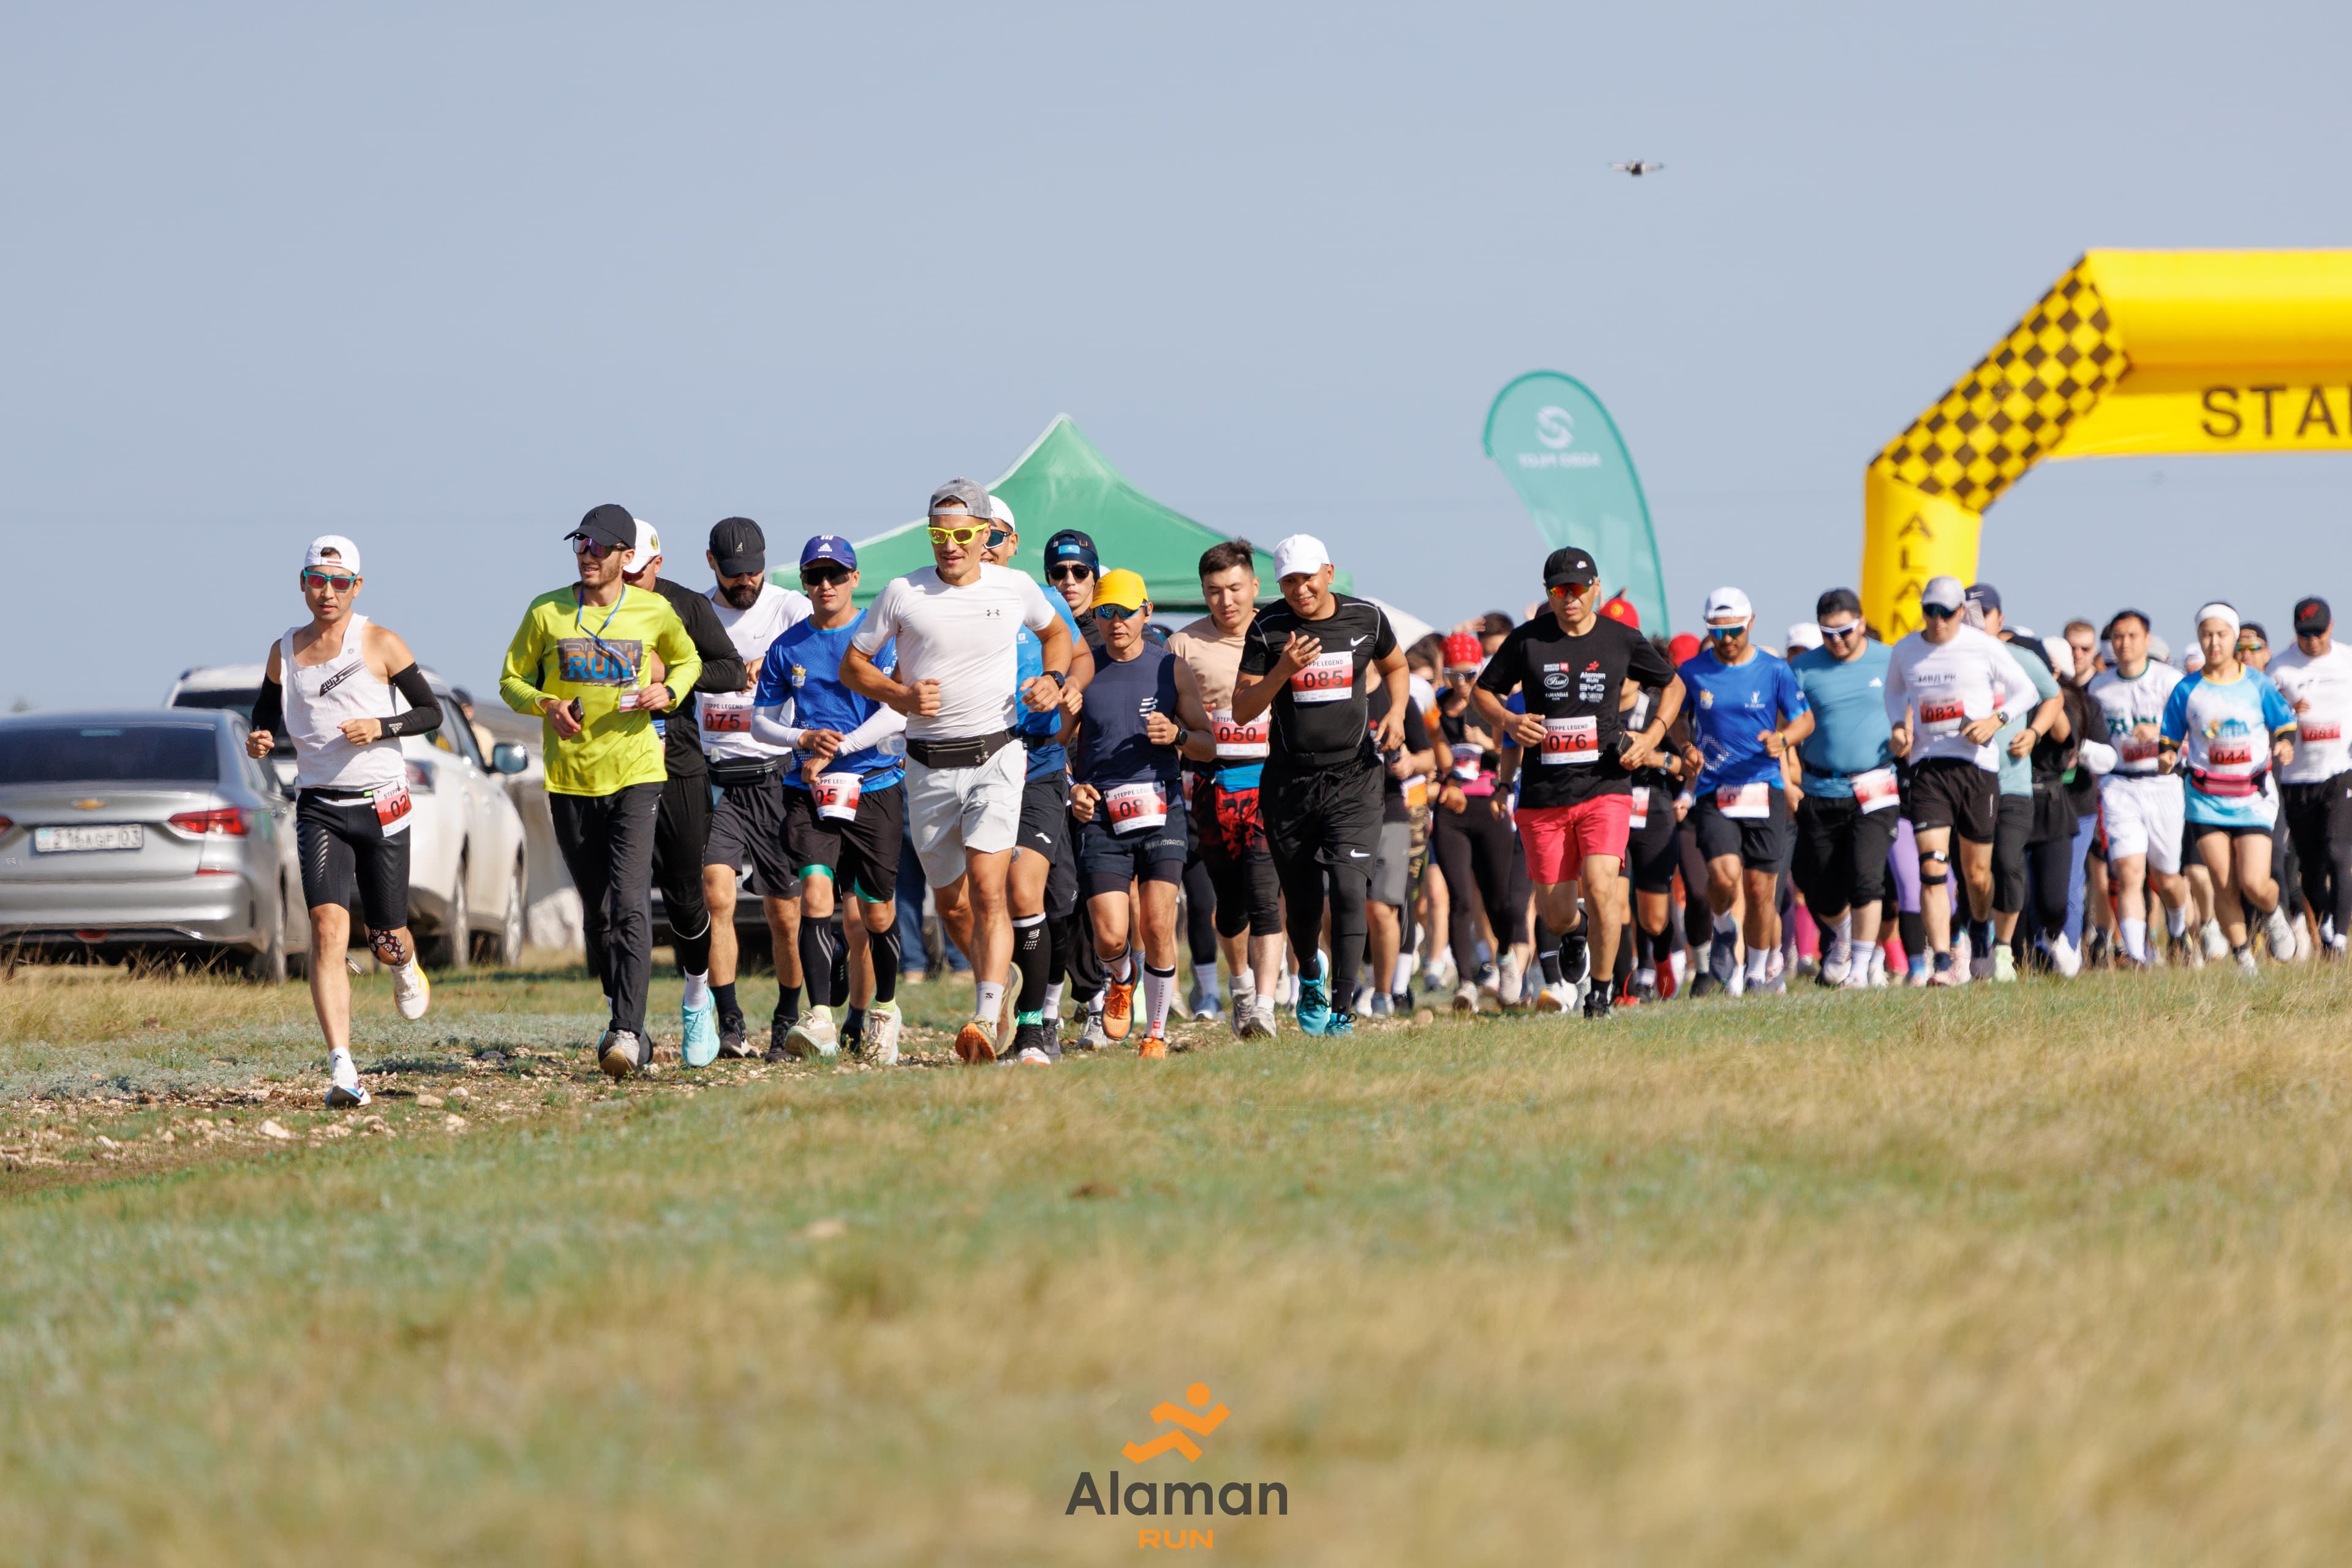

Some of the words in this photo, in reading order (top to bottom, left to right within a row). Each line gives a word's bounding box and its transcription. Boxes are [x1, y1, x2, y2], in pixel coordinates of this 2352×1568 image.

[1303, 669, 1344, 688] 085
[705, 713, 741, 729] 075
[1219, 726, 1256, 742] 050
[1549, 734, 1587, 751] 076
[1114, 790, 1135, 799] STEPPE
